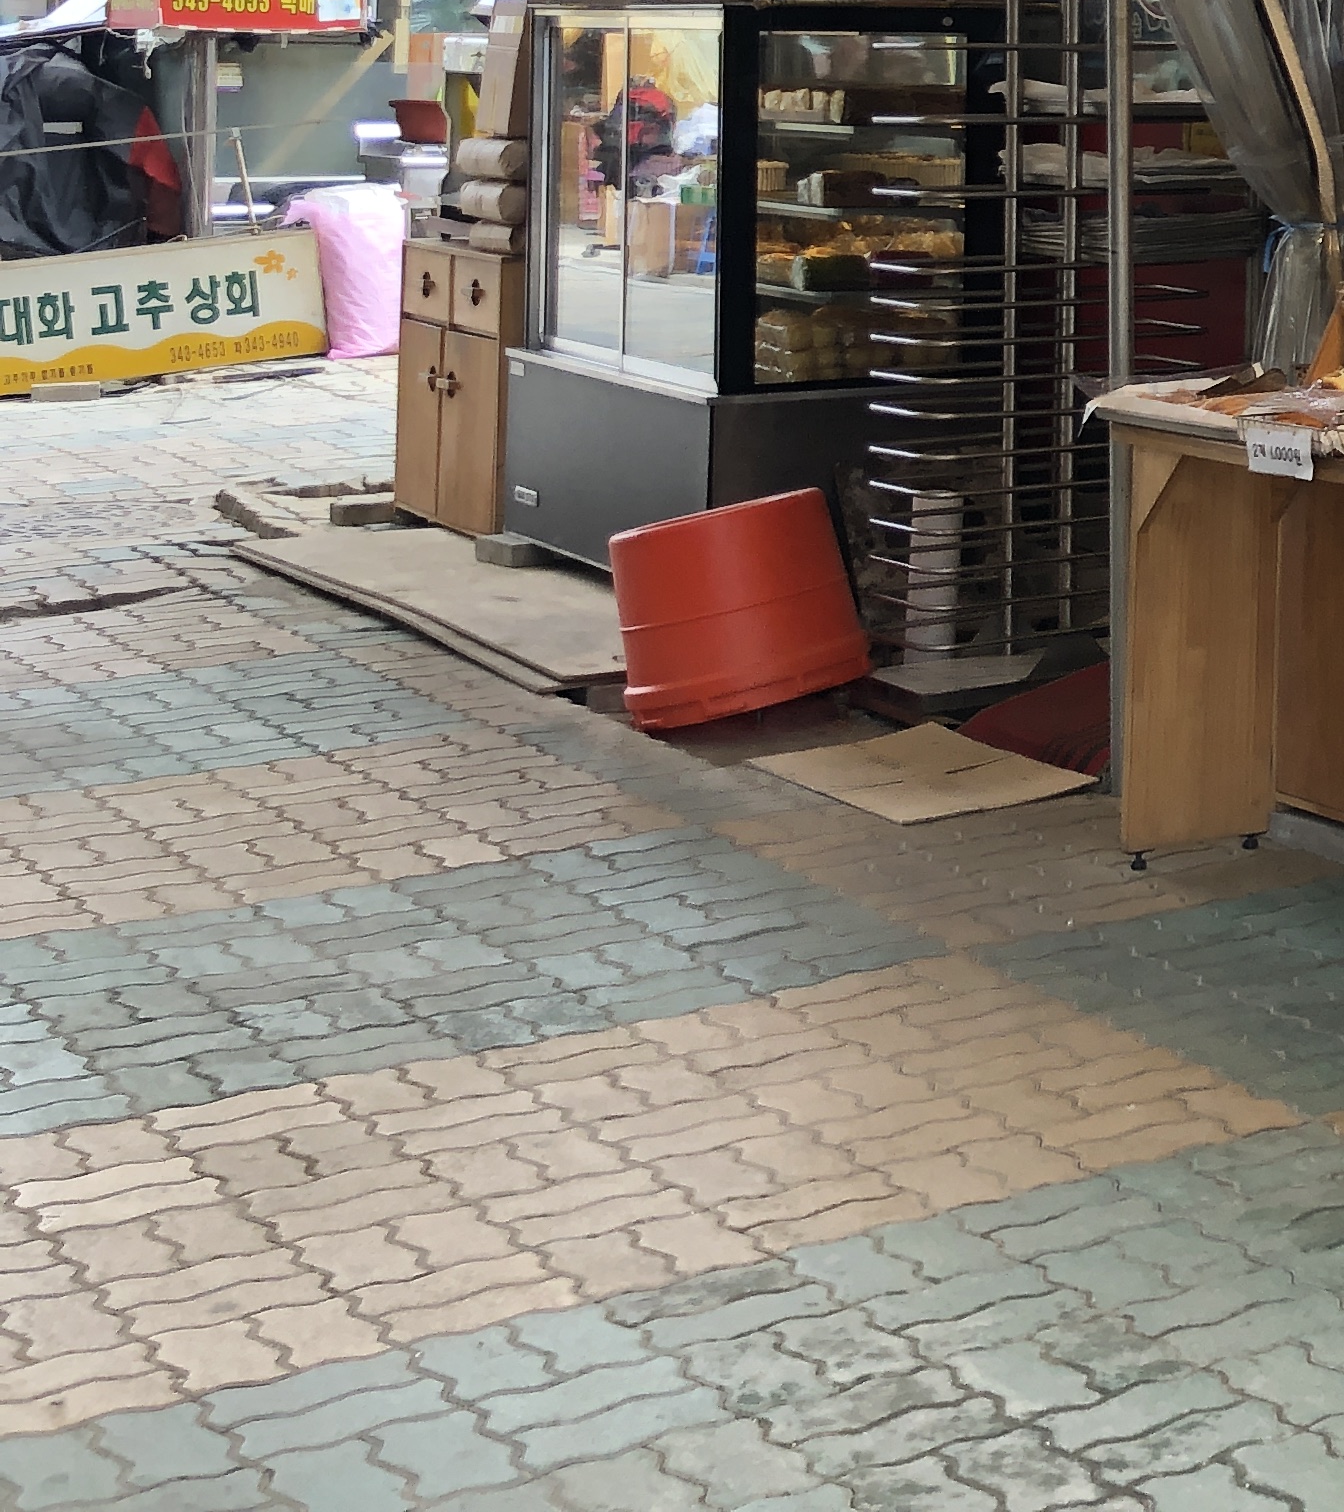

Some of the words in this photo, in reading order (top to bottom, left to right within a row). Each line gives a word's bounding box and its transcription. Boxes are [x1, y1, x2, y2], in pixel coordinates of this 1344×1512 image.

[0, 291, 76, 346] 대화
[91, 280, 175, 336] 고추
[184, 270, 260, 326] 상회
[168, 341, 226, 364] 343-4653
